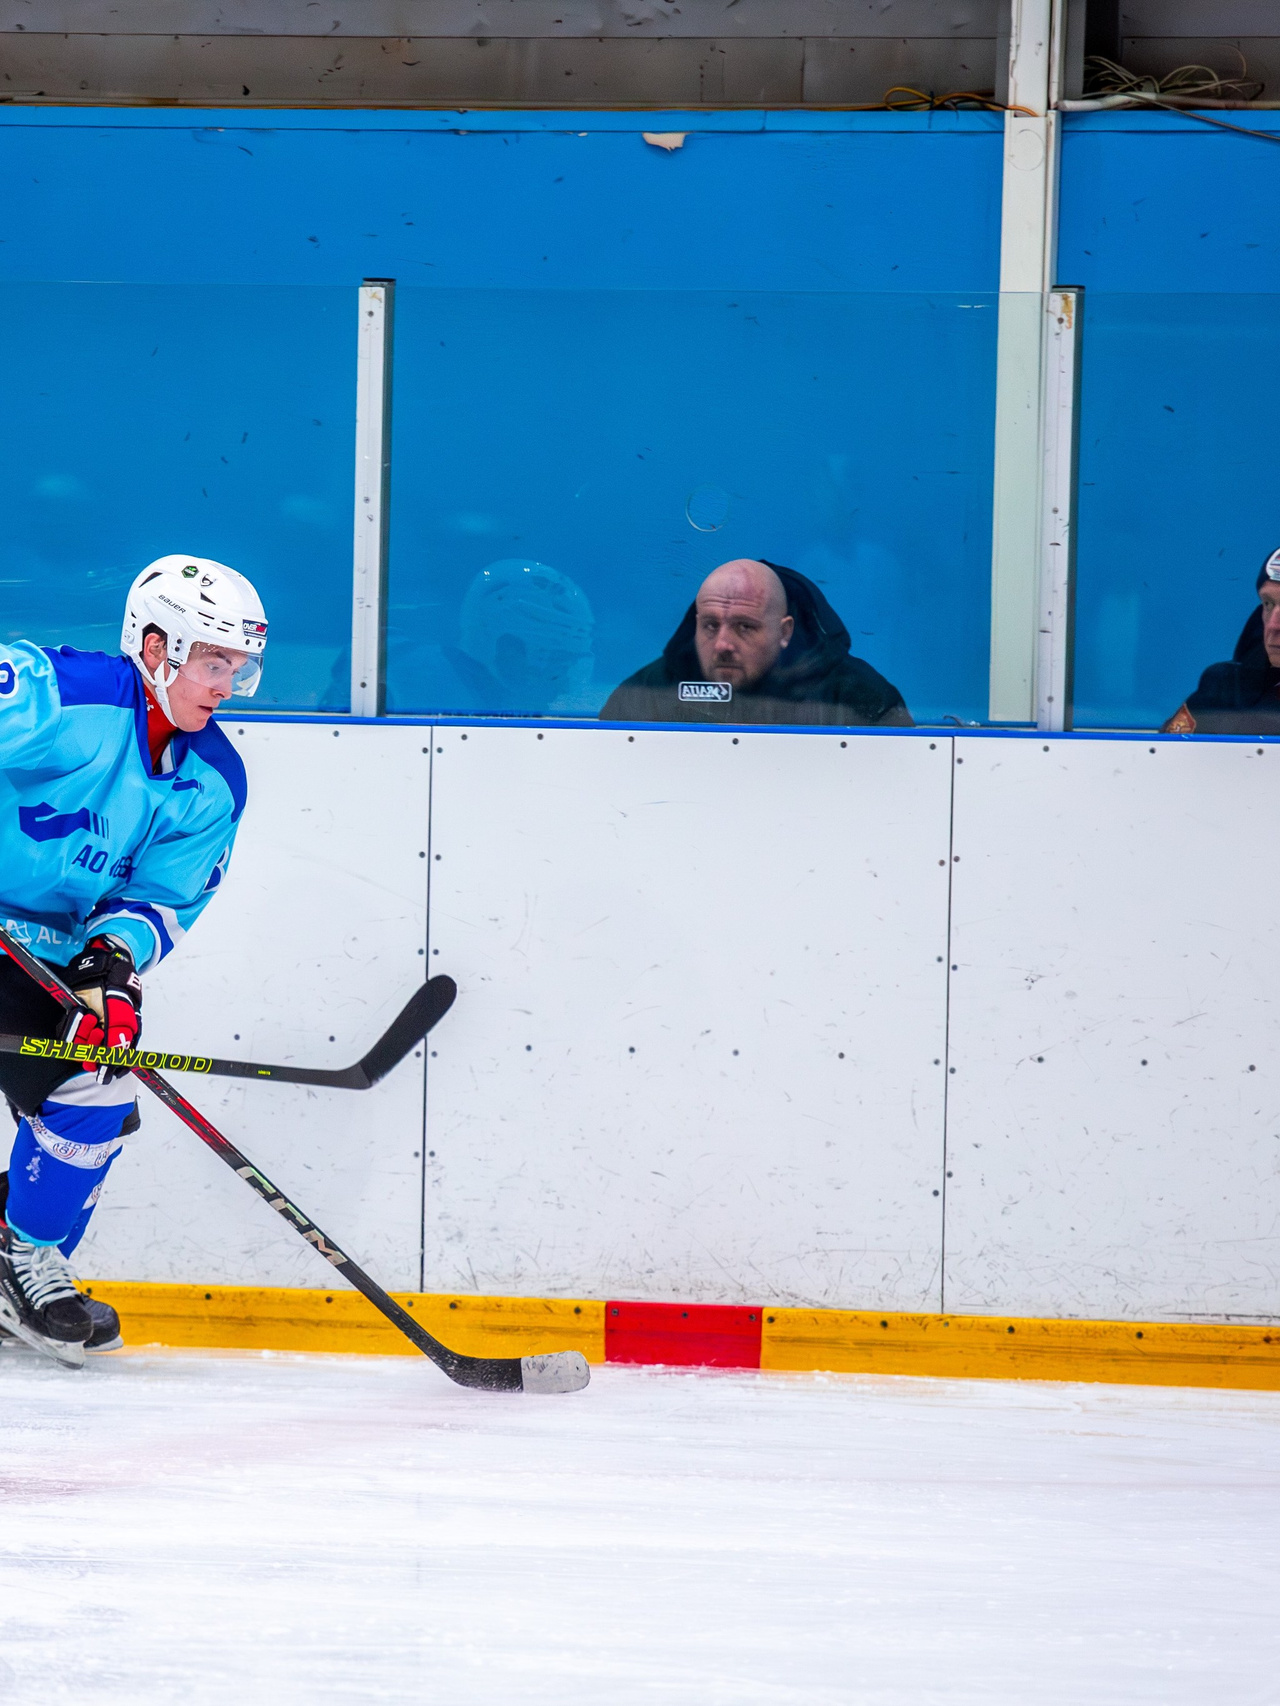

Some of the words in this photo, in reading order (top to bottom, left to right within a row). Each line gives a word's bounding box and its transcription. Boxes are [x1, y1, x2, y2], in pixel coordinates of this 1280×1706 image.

[158, 594, 187, 614] BAUER
[20, 1036, 213, 1074] SHERWOOD
[236, 1166, 348, 1266] CCM
